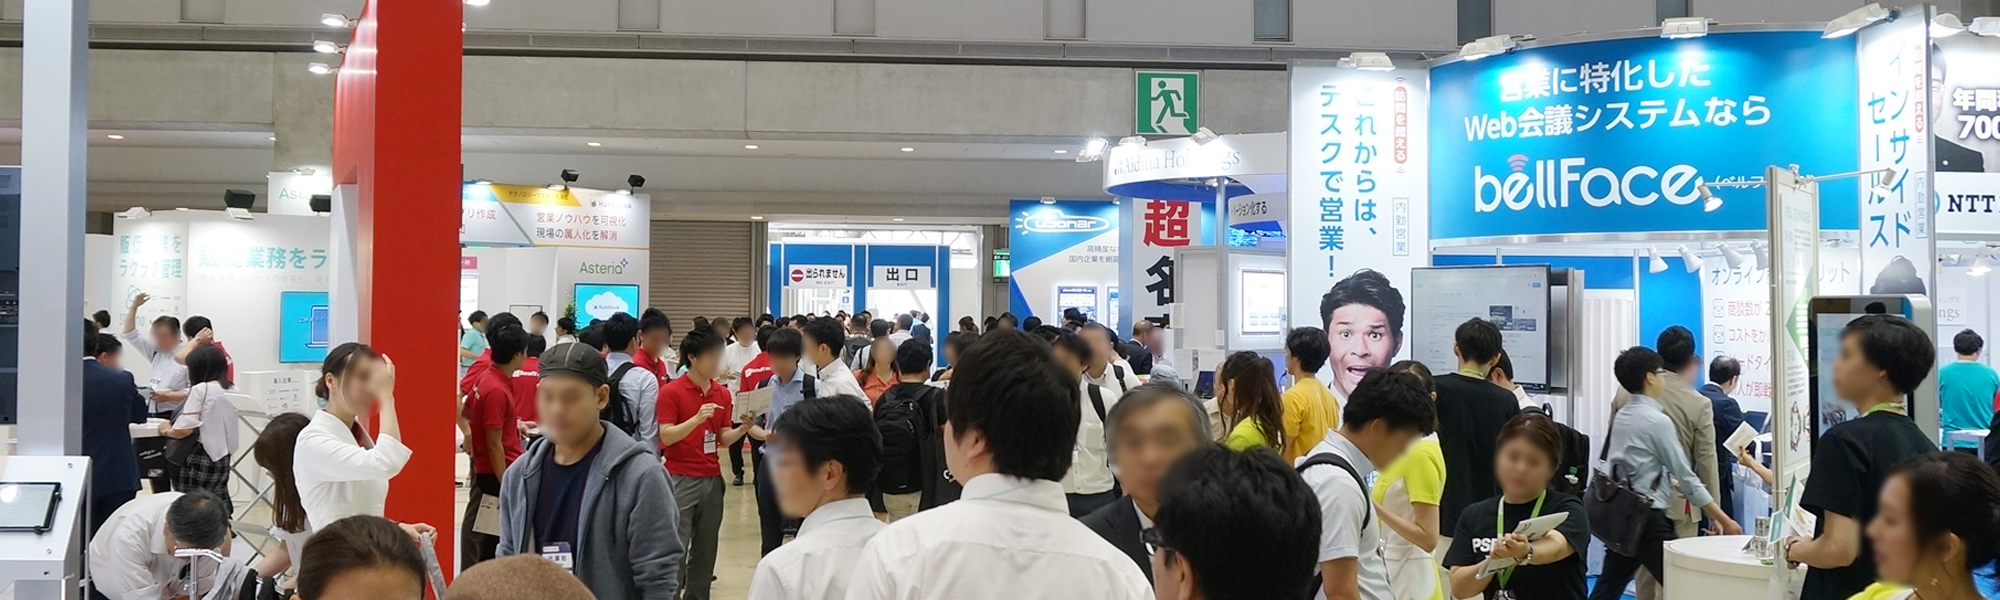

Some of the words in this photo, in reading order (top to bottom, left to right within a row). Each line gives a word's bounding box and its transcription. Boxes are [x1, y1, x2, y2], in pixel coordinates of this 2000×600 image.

[1500, 58, 1712, 103] 営業に特化した
[1464, 94, 1771, 142] Web会議システムなら
[1474, 156, 1704, 213] bellFace
[1947, 194, 1996, 213] NTT
[536, 211, 627, 228] 営業ノウハウを可視化
[535, 226, 618, 242] 現場の属人化を解消
[119, 258, 182, 279] ラクラク管理
[579, 262, 623, 275] Asteria
[805, 267, 846, 280] 出られません
[886, 266, 919, 282] 出口
[1710, 265, 1771, 286] オンライン
